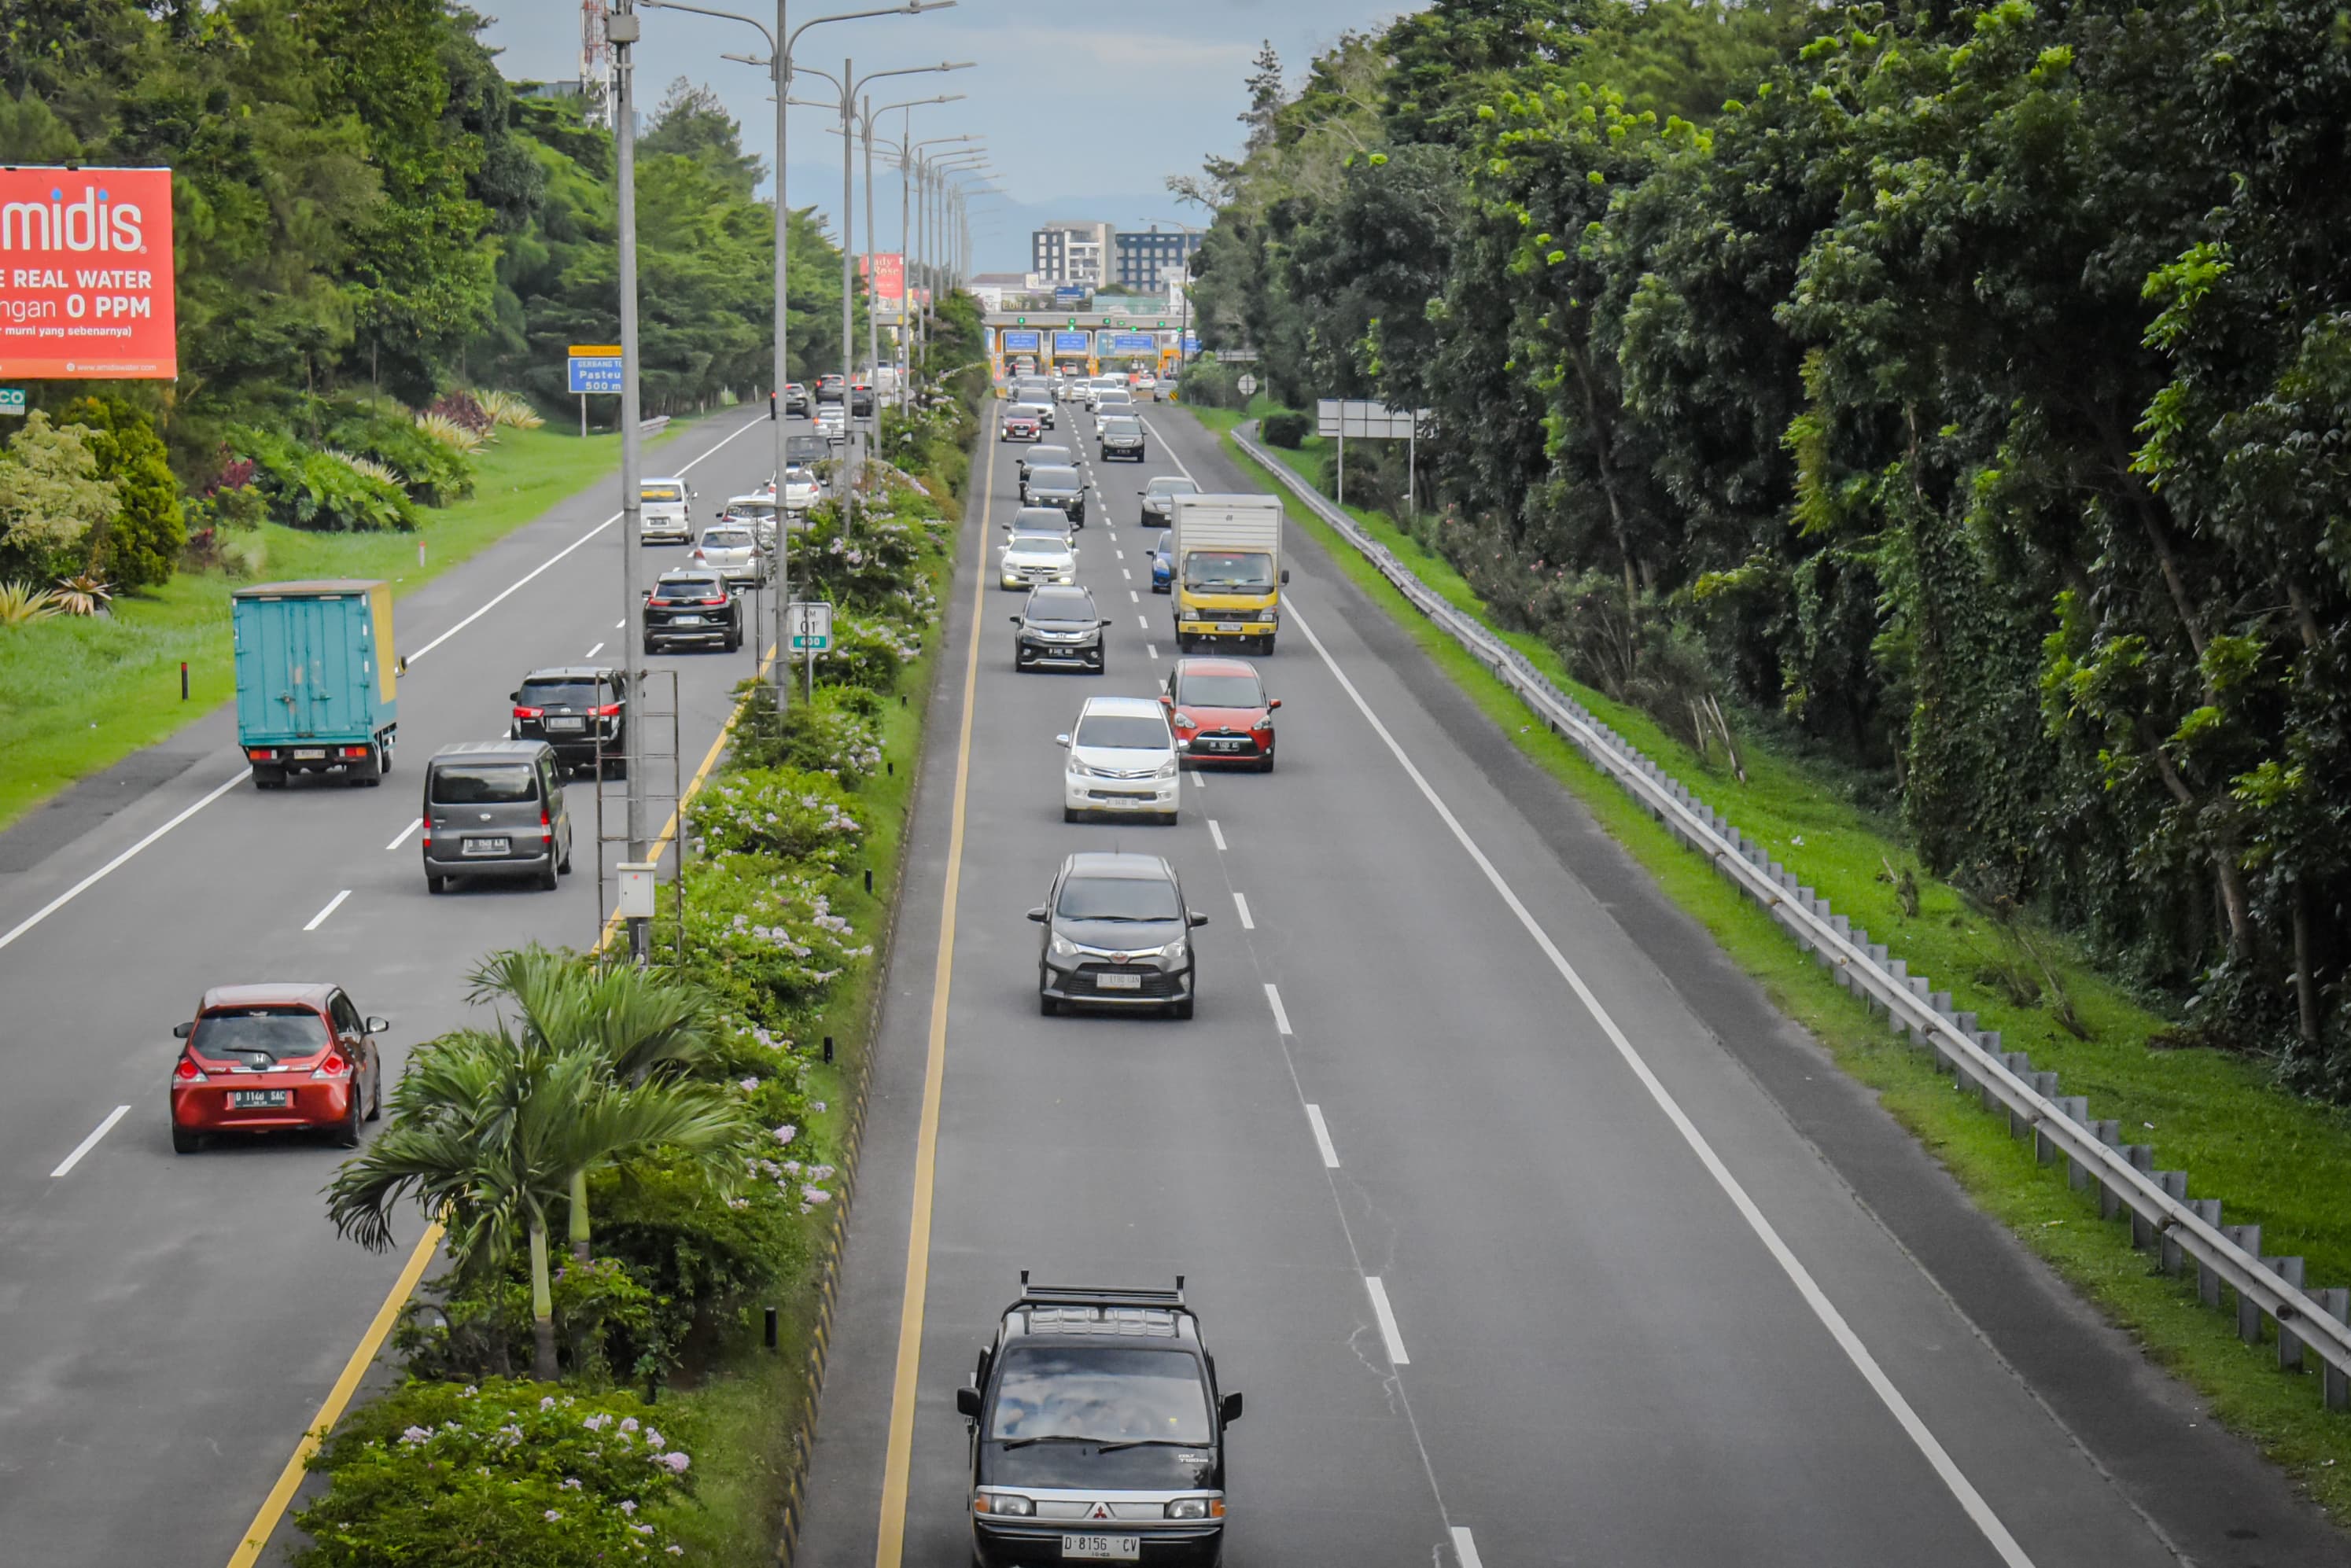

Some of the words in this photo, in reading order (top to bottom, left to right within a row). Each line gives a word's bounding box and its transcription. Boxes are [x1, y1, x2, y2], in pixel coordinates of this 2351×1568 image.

[2, 186, 142, 252] midis
[13, 270, 68, 288] REAL
[76, 270, 152, 289] WATER
[0, 300, 56, 322] ngan
[96, 296, 150, 318] PPM
[5, 326, 35, 335] murni
[39, 326, 64, 337] yang
[68, 326, 132, 337] sebenarnya)
[586, 381, 608, 390] 500
[271, 1091, 285, 1100] SAC
[1064, 1537, 1072, 1550] D
[1078, 1537, 1107, 1551] 8156
[1122, 1538, 1137, 1551] CV
